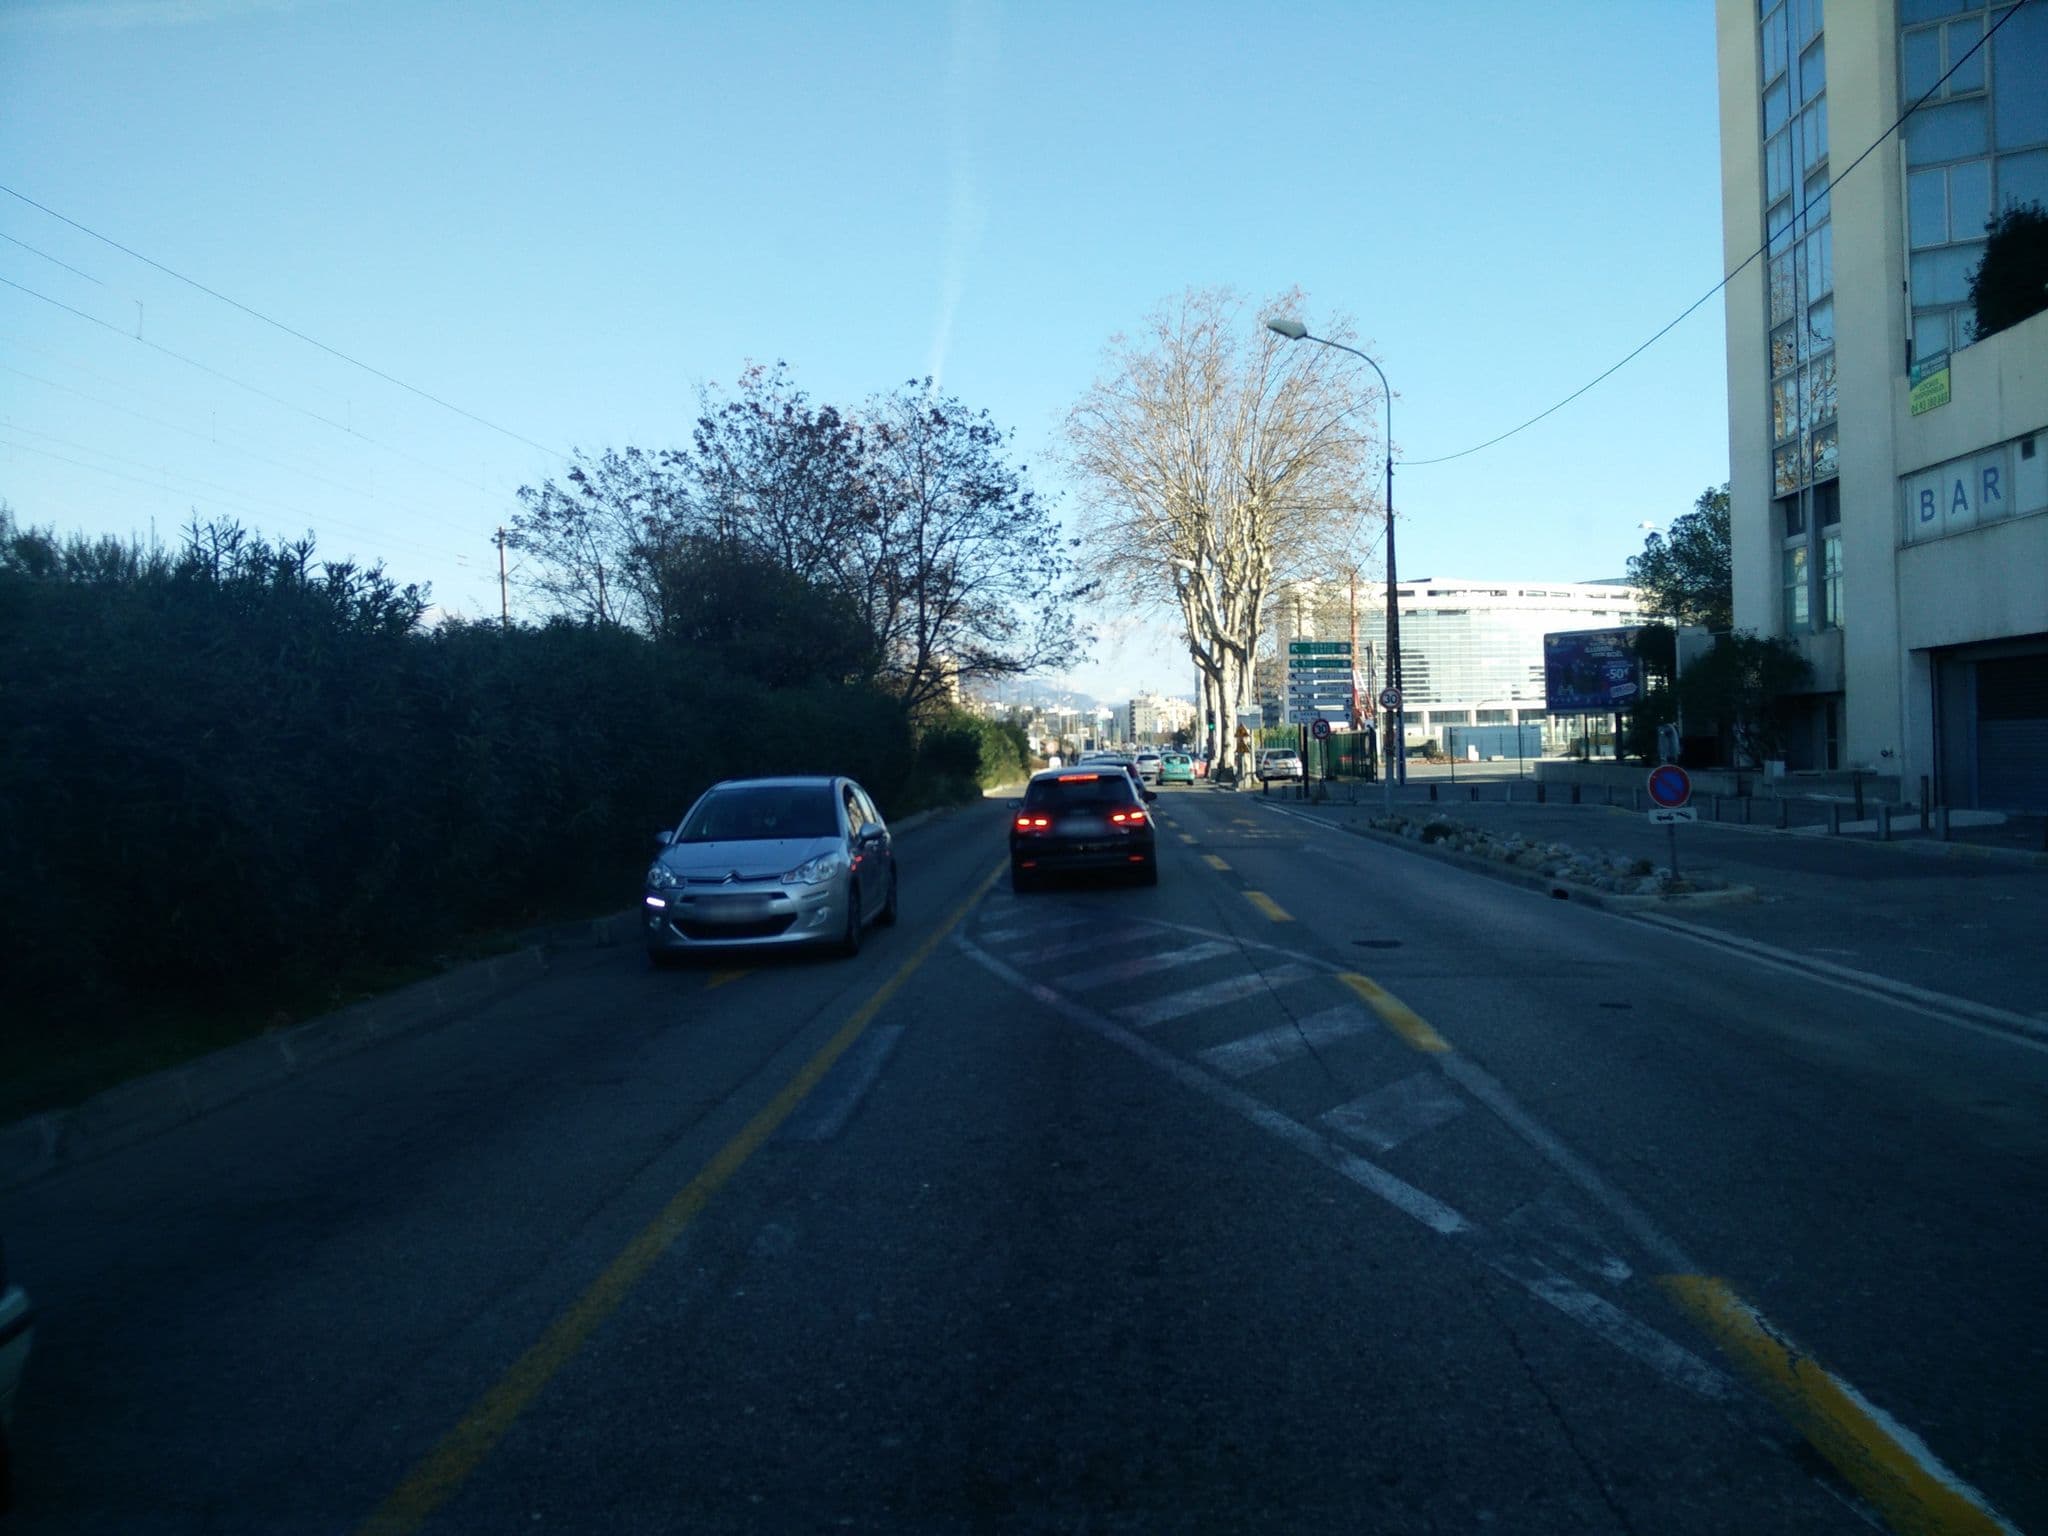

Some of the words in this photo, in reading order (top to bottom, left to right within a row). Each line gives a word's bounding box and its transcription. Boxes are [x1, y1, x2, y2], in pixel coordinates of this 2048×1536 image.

[1920, 466, 2001, 522] BAR
[1385, 694, 1397, 704] 30
[1316, 724, 1326, 734] 30
